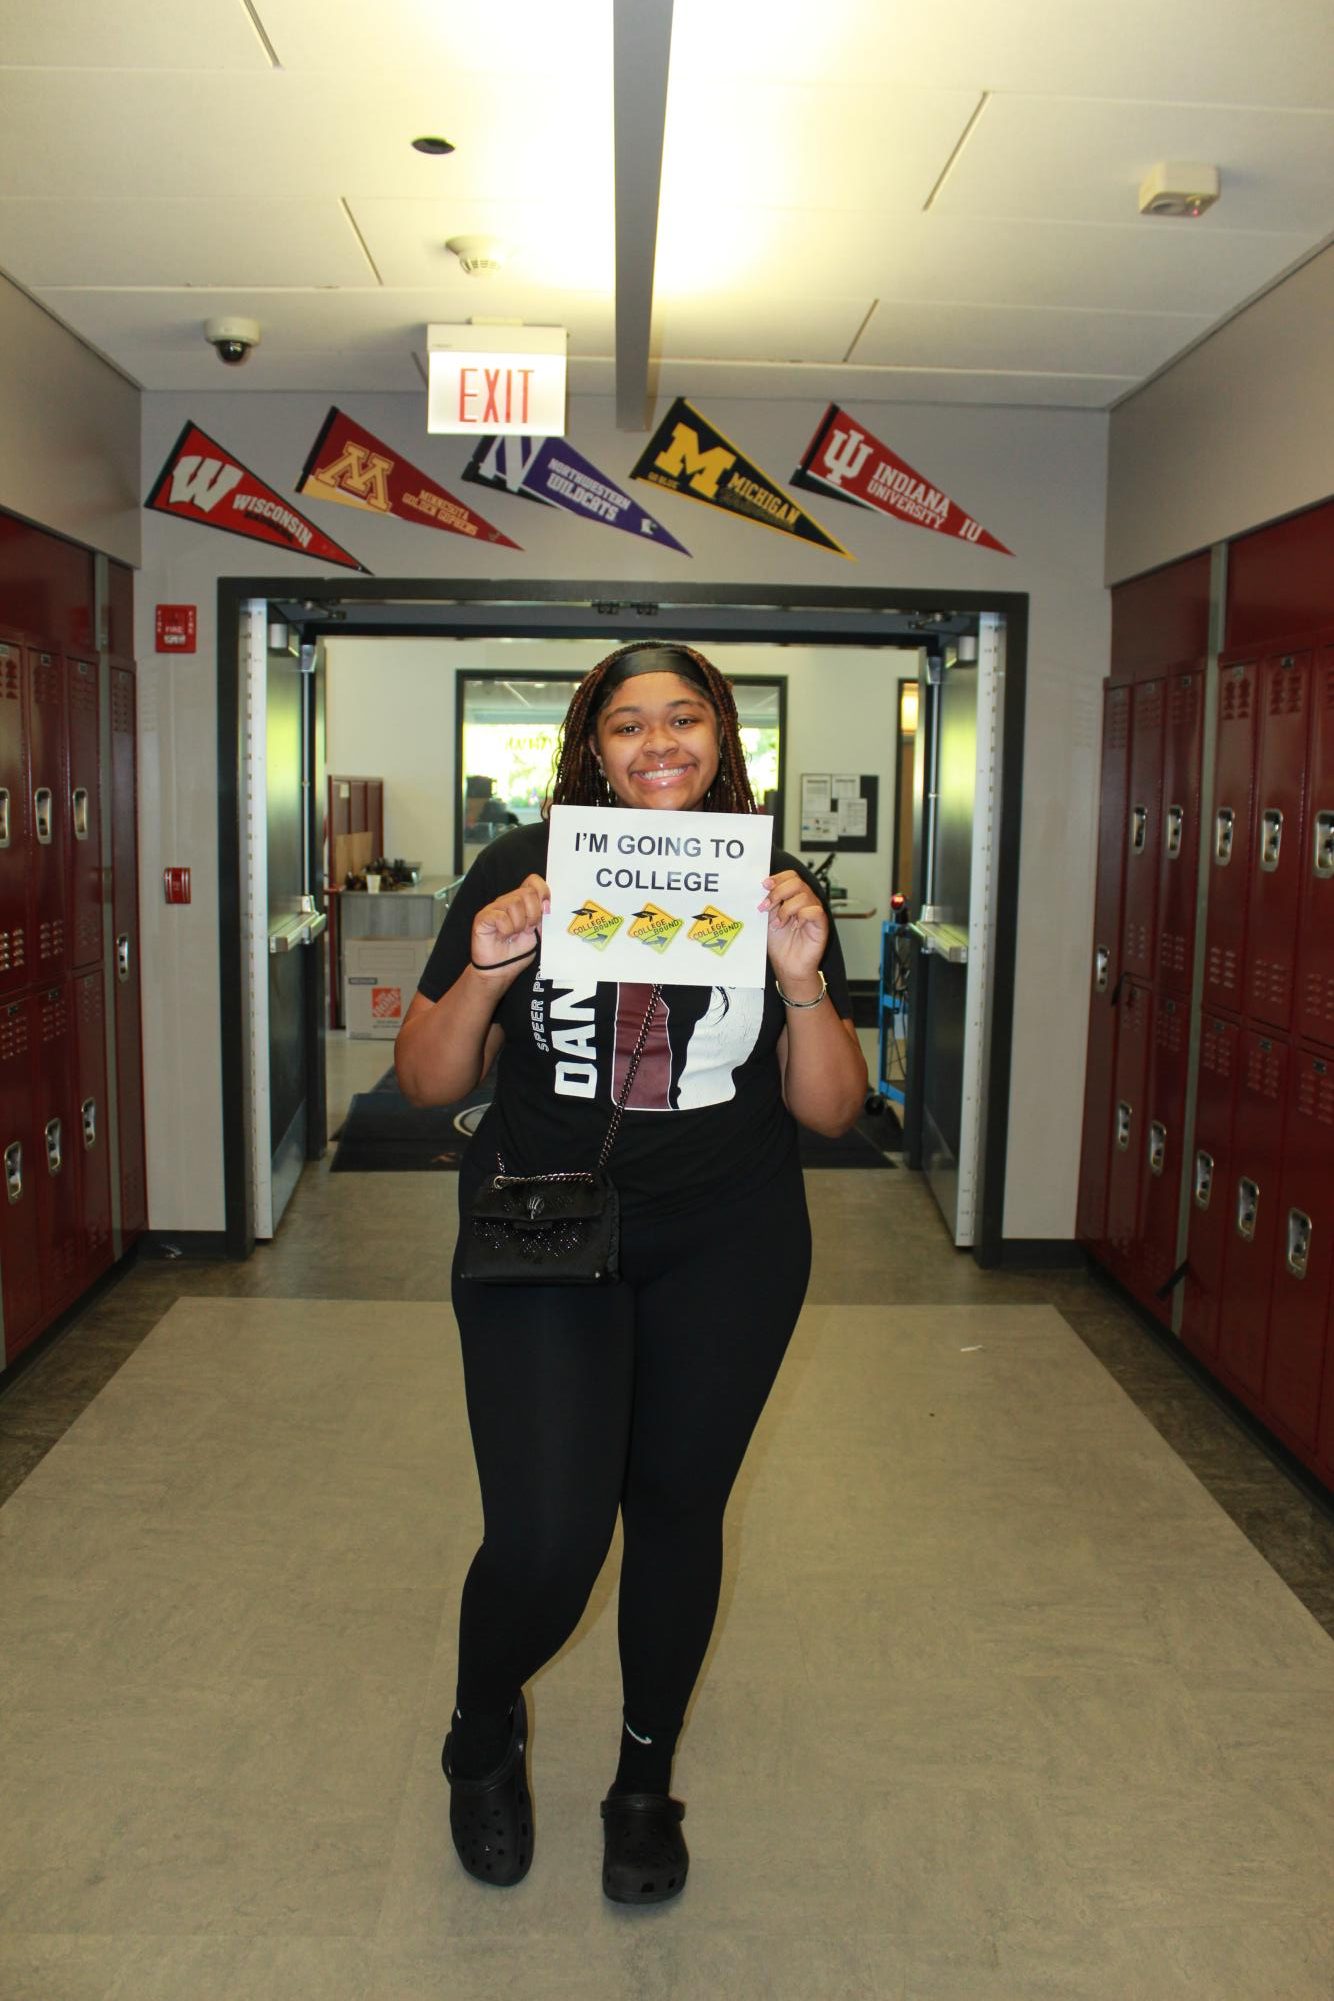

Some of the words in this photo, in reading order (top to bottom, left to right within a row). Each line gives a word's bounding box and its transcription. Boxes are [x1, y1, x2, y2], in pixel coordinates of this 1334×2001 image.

[459, 368, 535, 424] EXIT
[169, 455, 244, 513] W
[314, 440, 394, 512] M
[548, 458, 631, 512] NORTHWESTERN
[654, 421, 737, 499] M
[419, 489, 469, 521] MINNESOTA
[547, 472, 619, 522] WILDCATS
[727, 471, 801, 525] MICHIGAN
[866, 479, 946, 529] UNIVERSITY
[872, 461, 950, 517] INDIANA
[232, 493, 313, 549] WISCONSIN
[959, 518, 984, 542] IU
[575, 832, 608, 853] I'M
[617, 835, 702, 858] GOING
[710, 839, 745, 859] TO
[596, 868, 719, 892] COLLEGE
[573, 916, 607, 935] COLLEGE
[593, 917, 619, 932] BOUND
[633, 918, 667, 937] COLLEGE
[653, 919, 680, 935] BOUND
[693, 921, 727, 940] COLLEGE
[713, 922, 740, 937] BOUND
[530, 999, 550, 1053] SPEER
